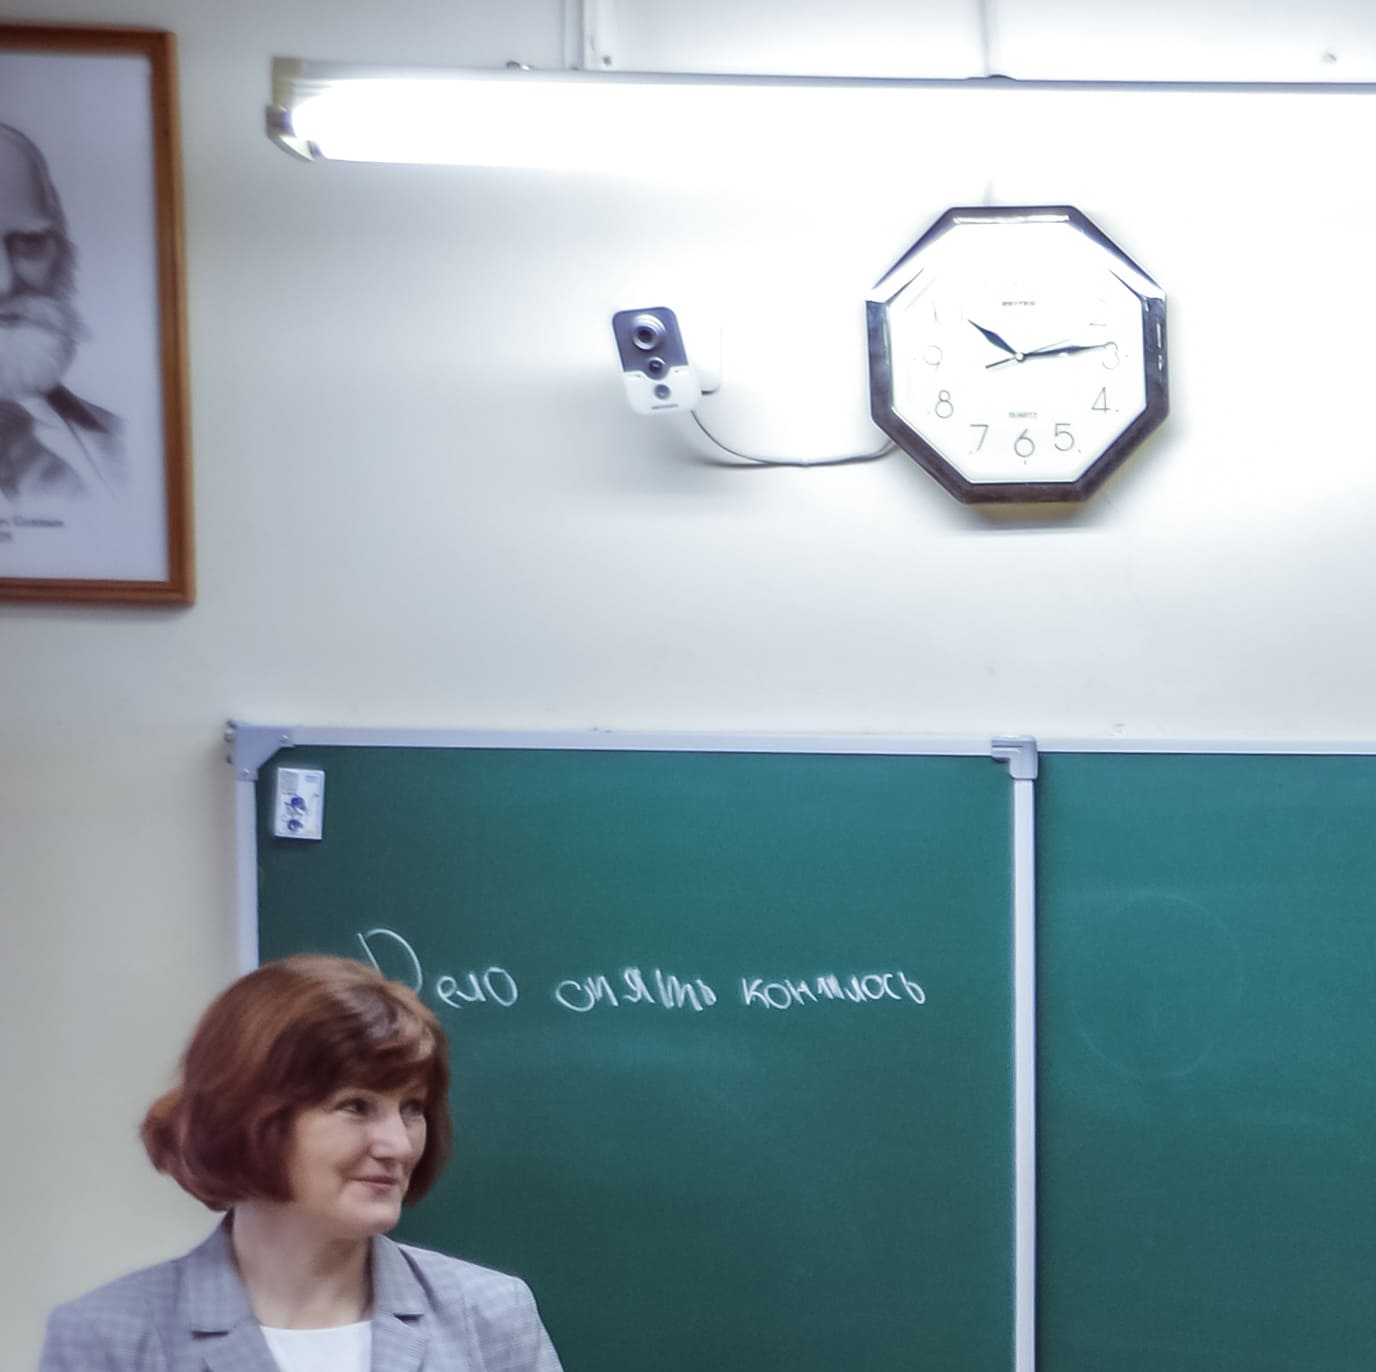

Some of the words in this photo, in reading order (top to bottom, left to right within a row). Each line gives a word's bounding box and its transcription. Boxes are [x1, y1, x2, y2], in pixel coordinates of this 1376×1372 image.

[1101, 341, 1119, 370] 3
[934, 389, 954, 419] 8
[1091, 387, 1111, 414] 4
[969, 424, 989, 451] 7
[1014, 429, 1035, 458] 6
[1054, 423, 1075, 451] 5
